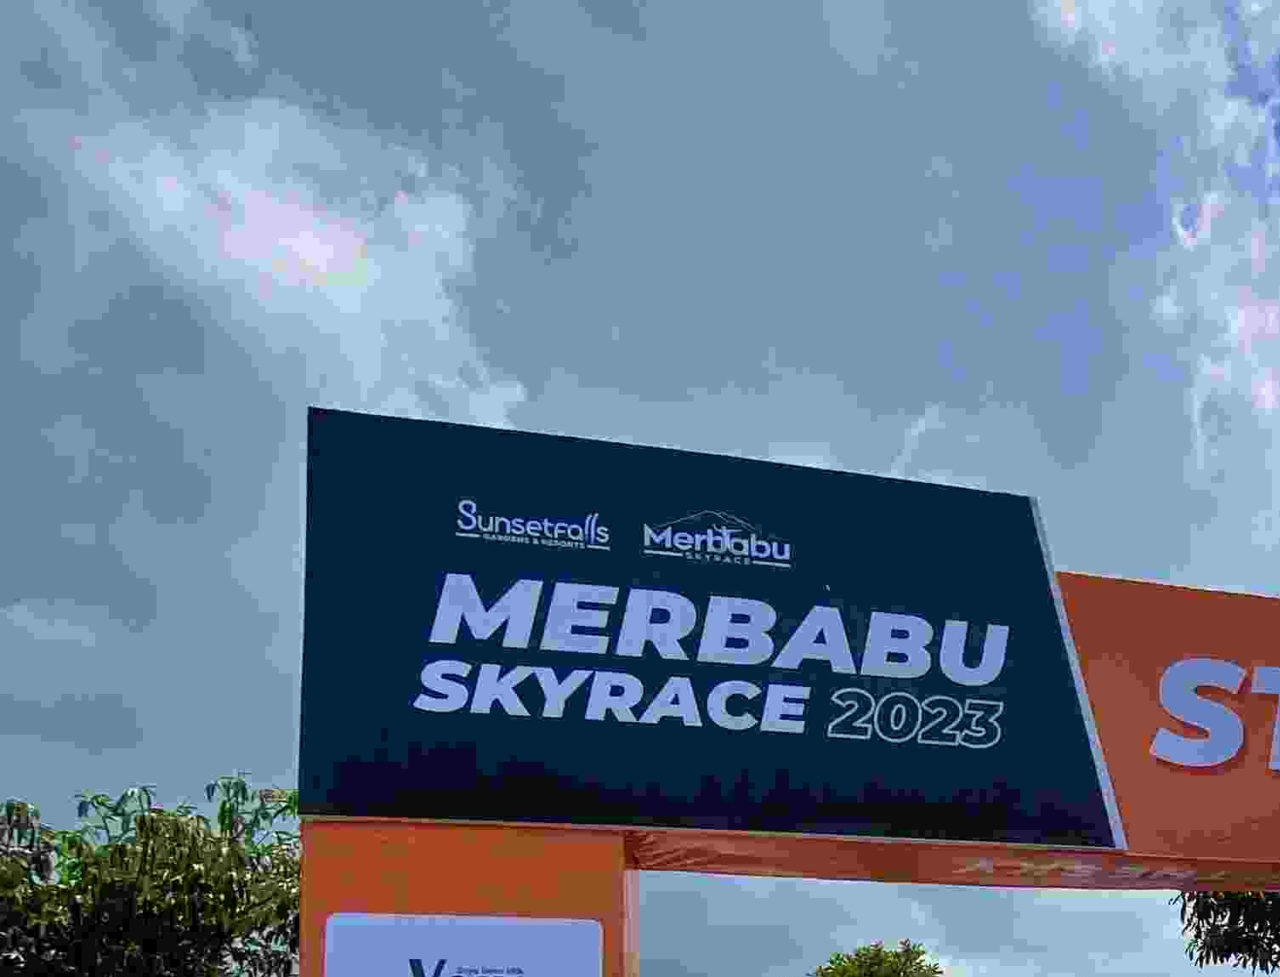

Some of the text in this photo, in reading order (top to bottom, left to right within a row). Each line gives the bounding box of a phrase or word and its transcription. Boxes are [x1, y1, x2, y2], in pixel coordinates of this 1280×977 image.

[428, 572, 1010, 686] MERBABU
[413, 660, 1004, 749] SKYRACE 2023
